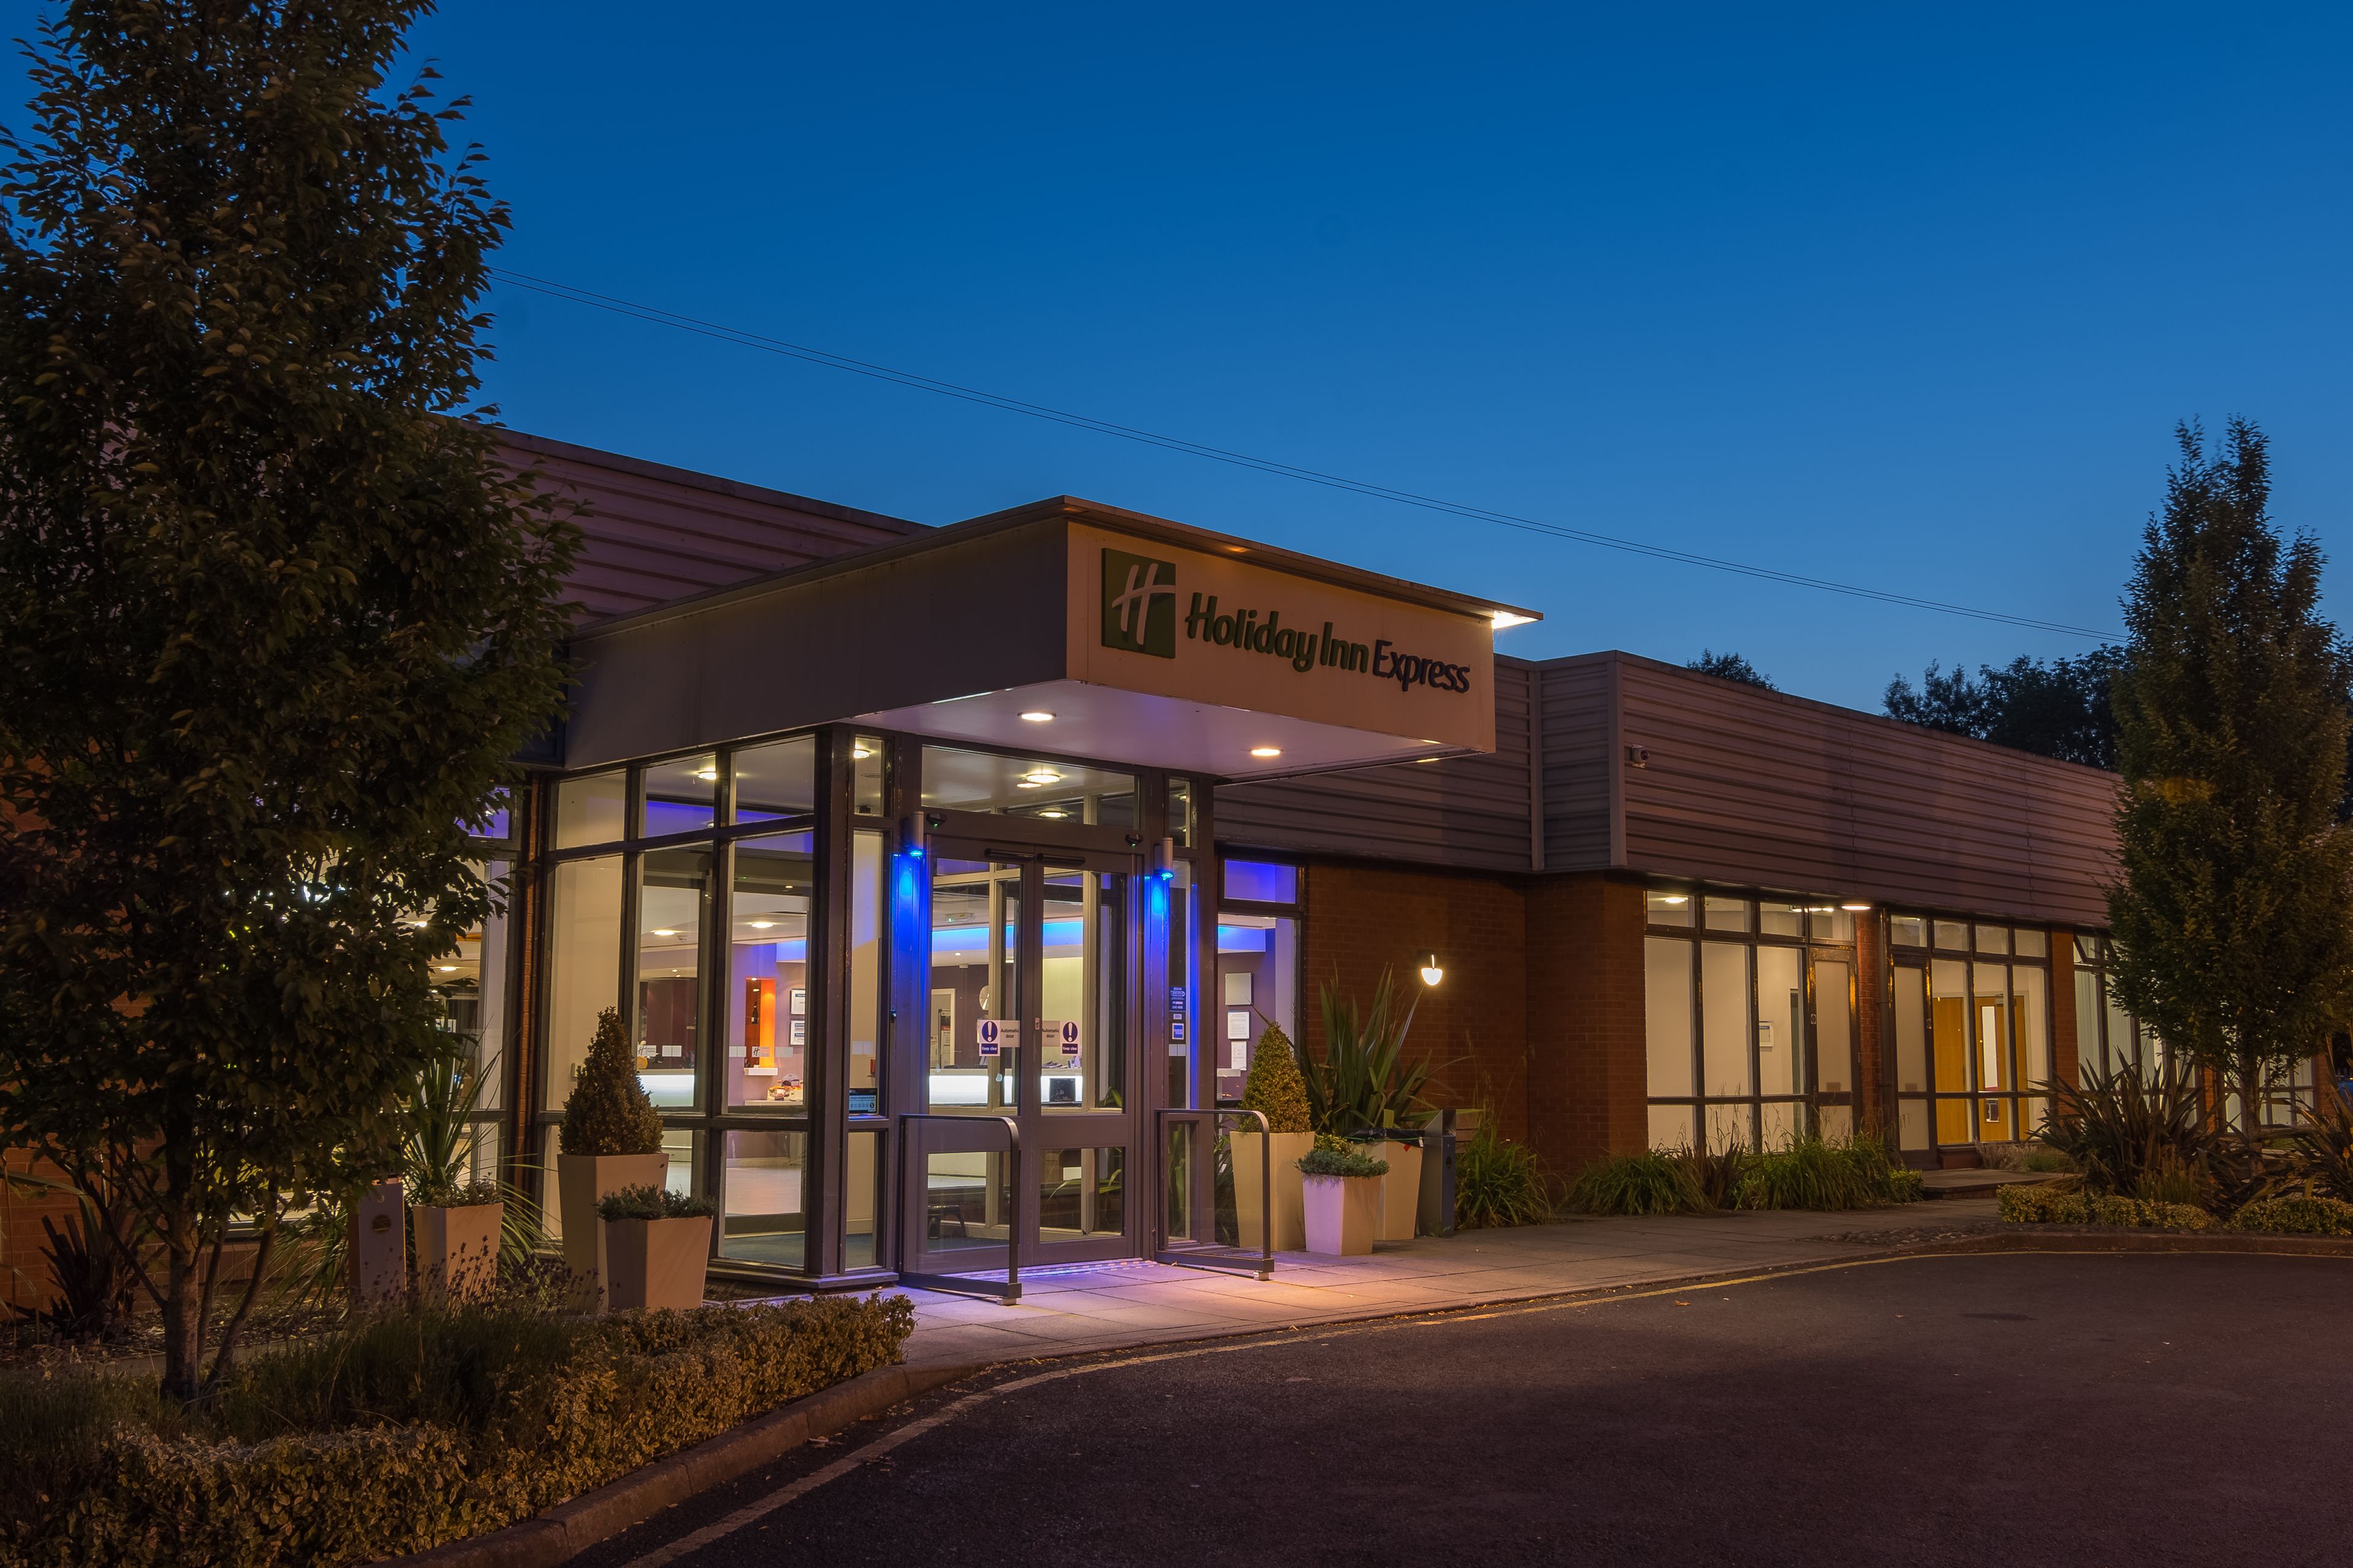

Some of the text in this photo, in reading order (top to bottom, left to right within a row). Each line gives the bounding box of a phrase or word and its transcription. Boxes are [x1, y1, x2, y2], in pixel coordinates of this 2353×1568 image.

[1184, 592, 1471, 693] Holiday Inn Express
